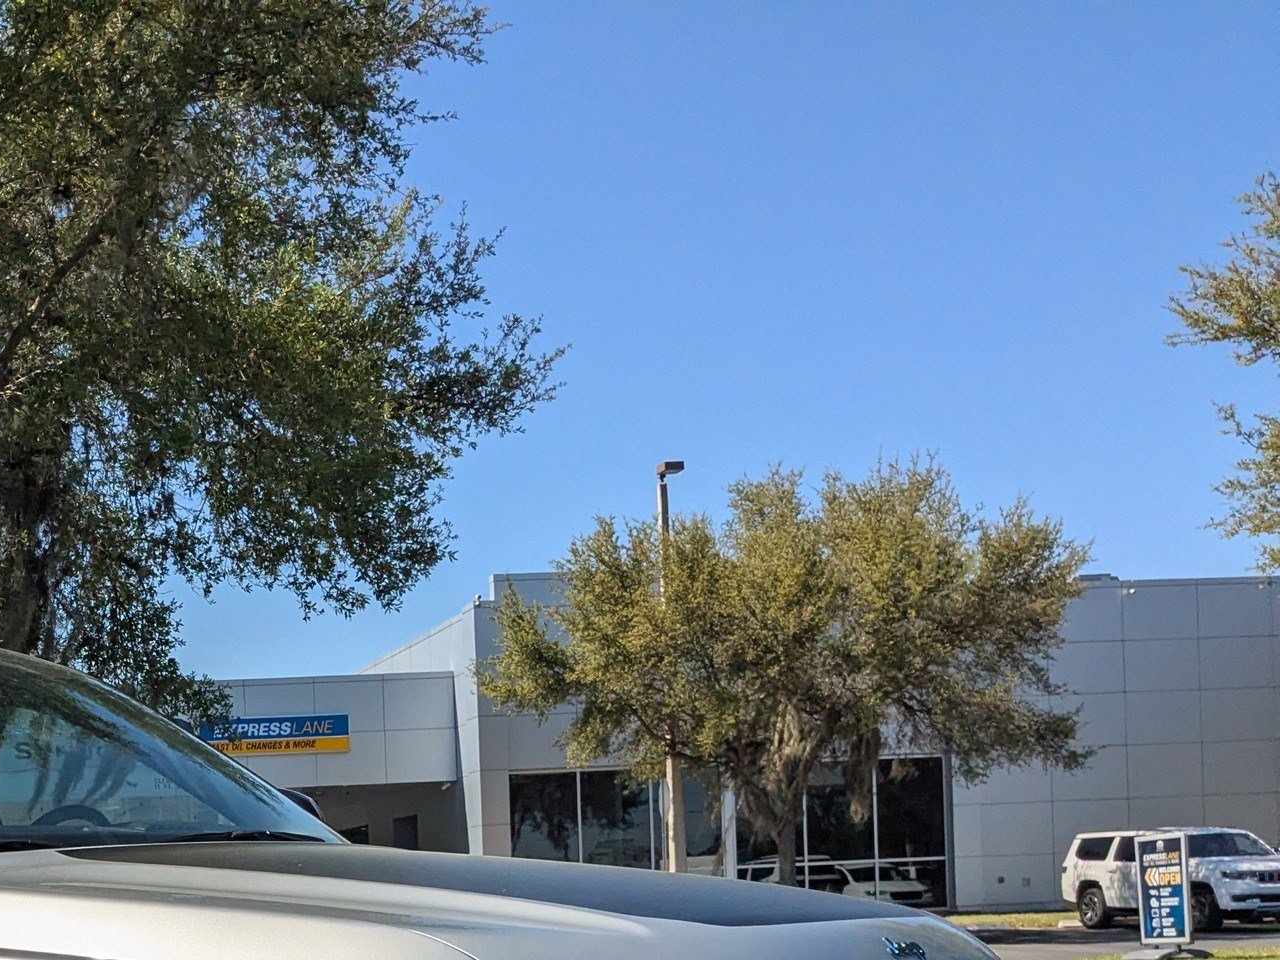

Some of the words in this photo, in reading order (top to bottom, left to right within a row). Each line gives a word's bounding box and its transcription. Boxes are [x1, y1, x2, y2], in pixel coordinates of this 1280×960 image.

[246, 741, 282, 750] CHANGES
[284, 741, 290, 749] &
[292, 739, 317, 749] MORE
[1159, 872, 1182, 886] OPEN
